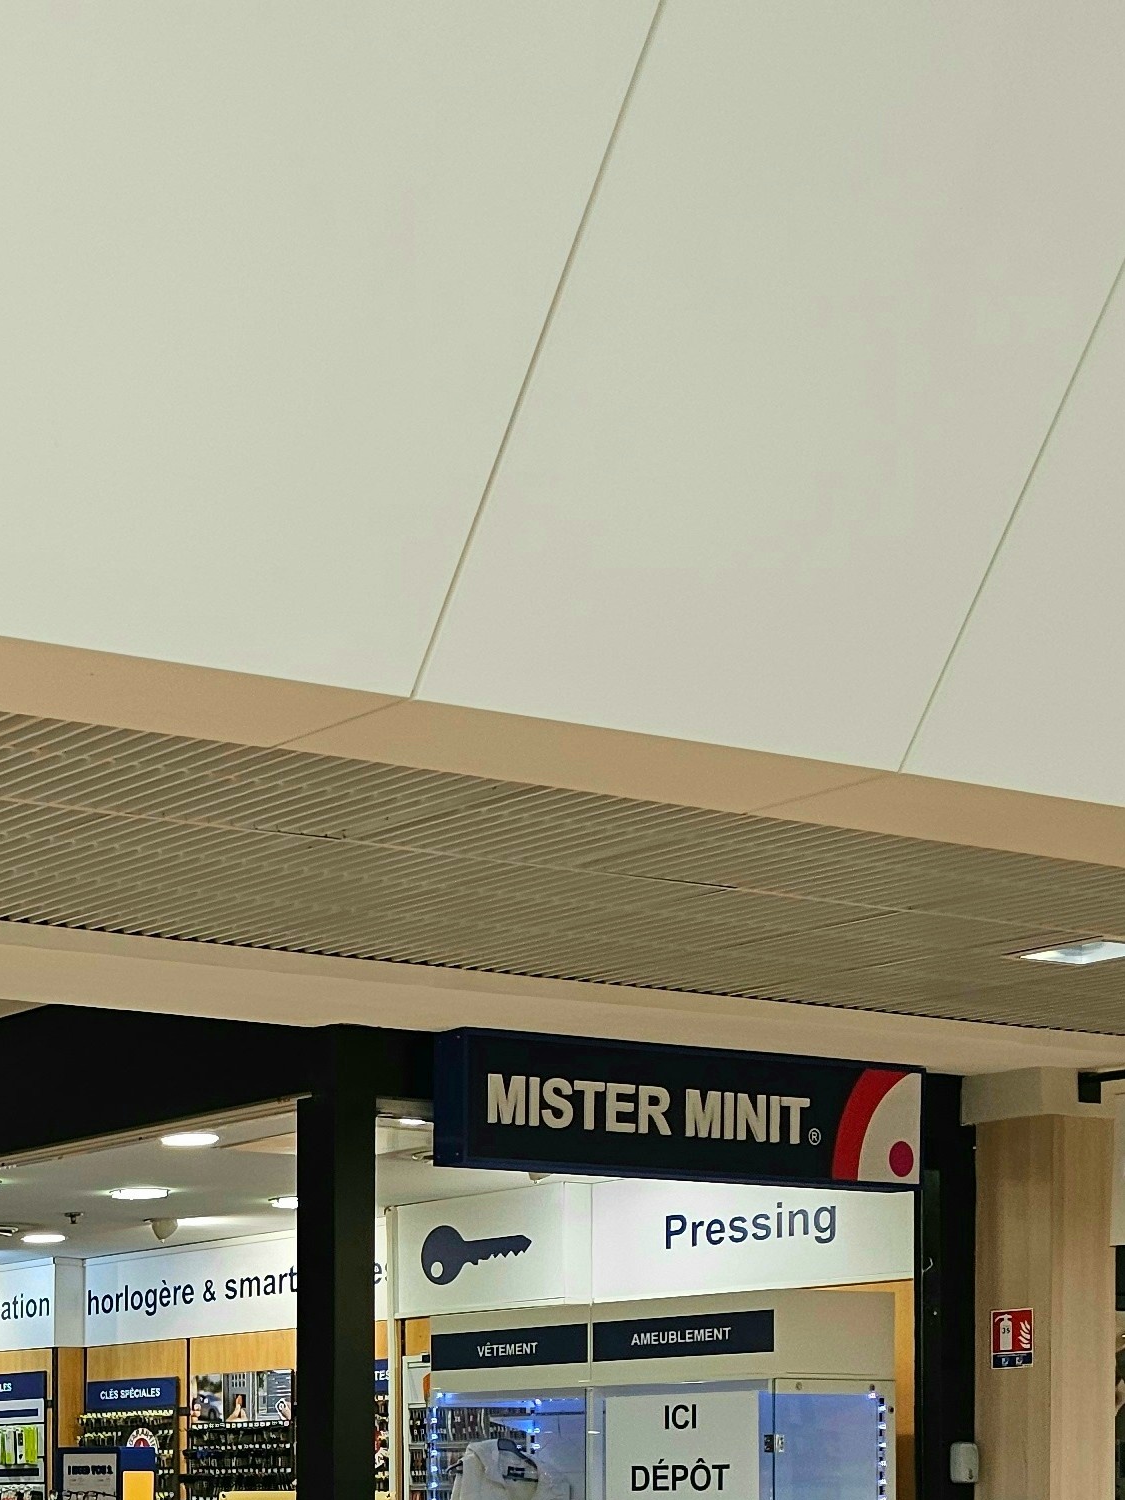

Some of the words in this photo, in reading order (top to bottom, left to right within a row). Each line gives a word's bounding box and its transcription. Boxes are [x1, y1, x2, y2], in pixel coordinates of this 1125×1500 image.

[487, 1073, 672, 1136] MISTER
[665, 1201, 837, 1250] Pressing
[87, 1279, 195, 1317] horlogère
[202, 1279, 216, 1302] &
[476, 1341, 538, 1358] VÊTEMENT
[630, 1327, 732, 1346] AMEUBLEMENT
[99, 1389, 119, 1400] CLÉS
[120, 1387, 161, 1399] SPÉCIALES
[664, 1403, 697, 1430] ICI
[630, 1458, 730, 1491] DÉPÔT
